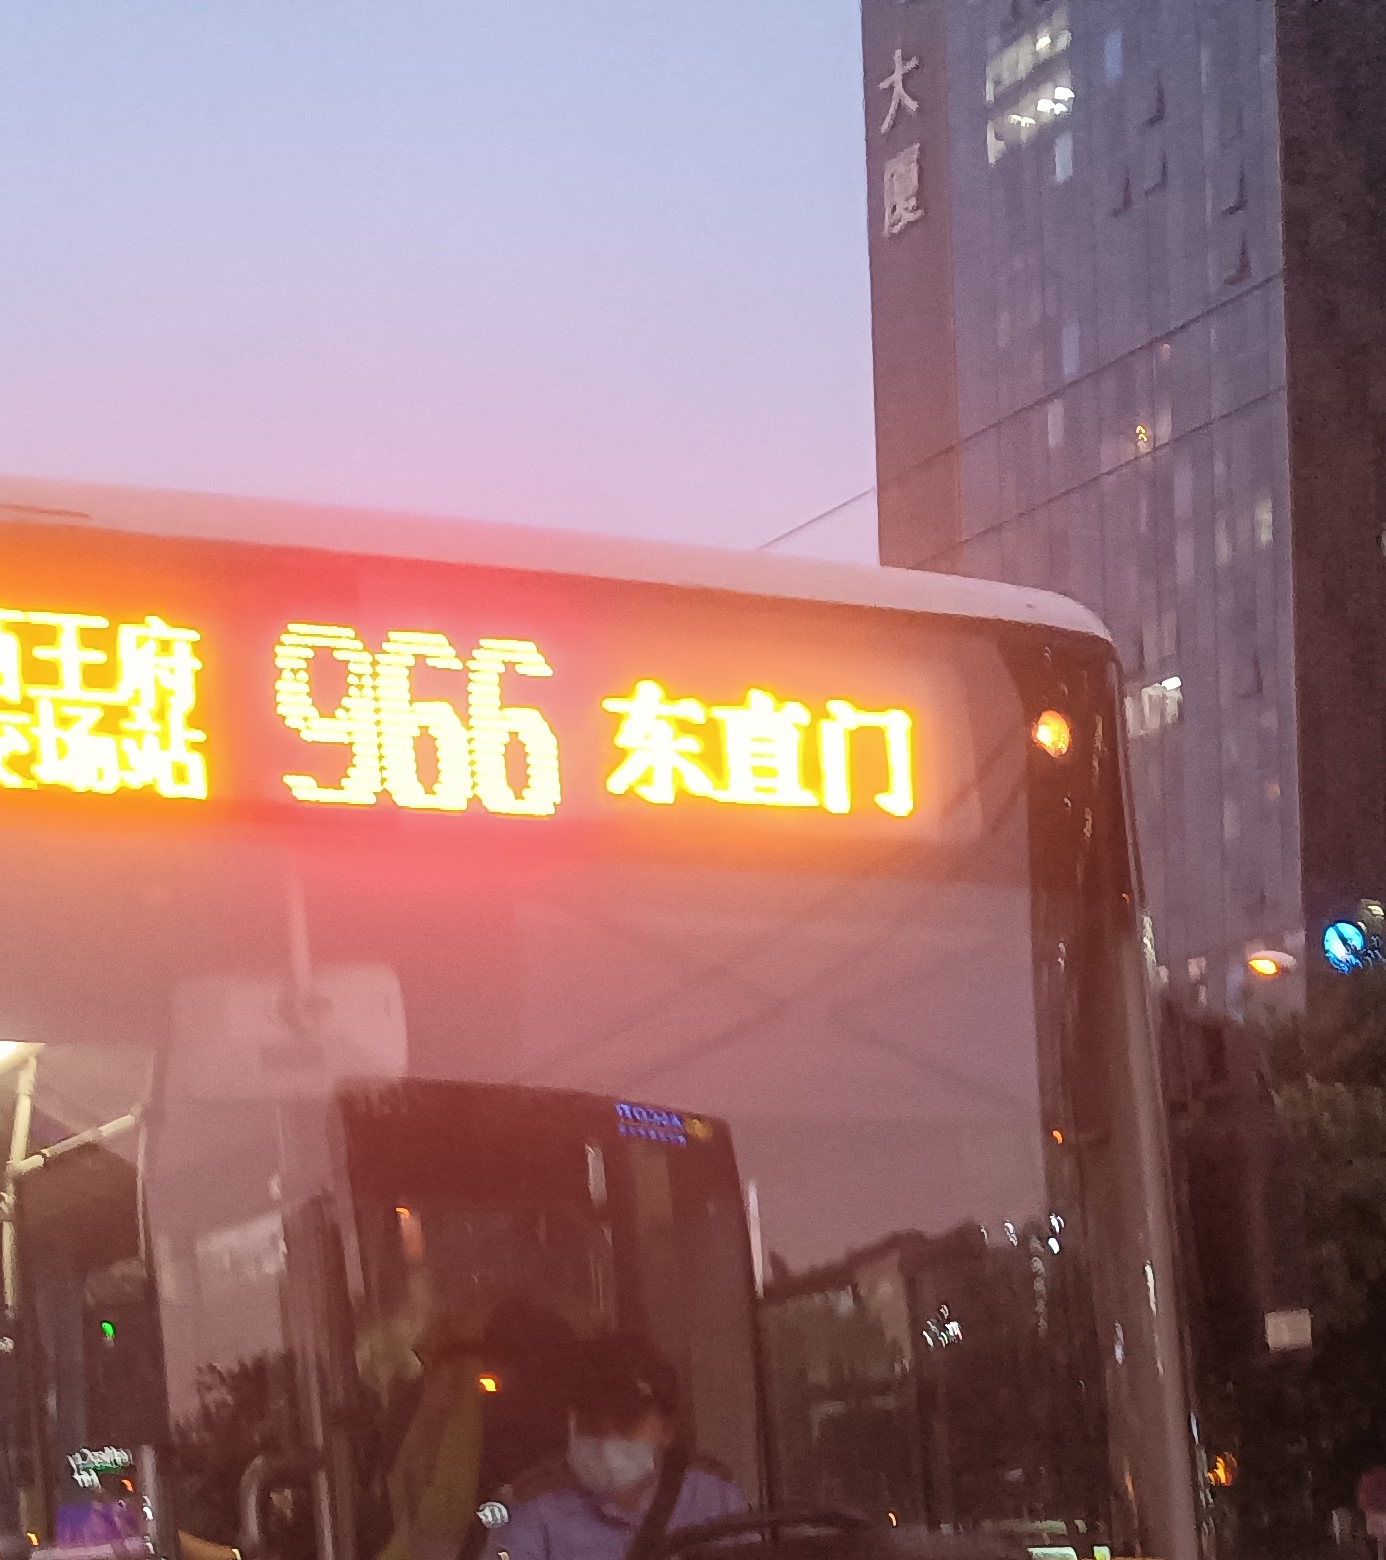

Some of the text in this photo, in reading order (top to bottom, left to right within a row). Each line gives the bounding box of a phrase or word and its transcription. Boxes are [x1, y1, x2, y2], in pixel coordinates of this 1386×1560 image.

[273, 622, 562, 815] 966
[603, 679, 916, 817] 东直门
